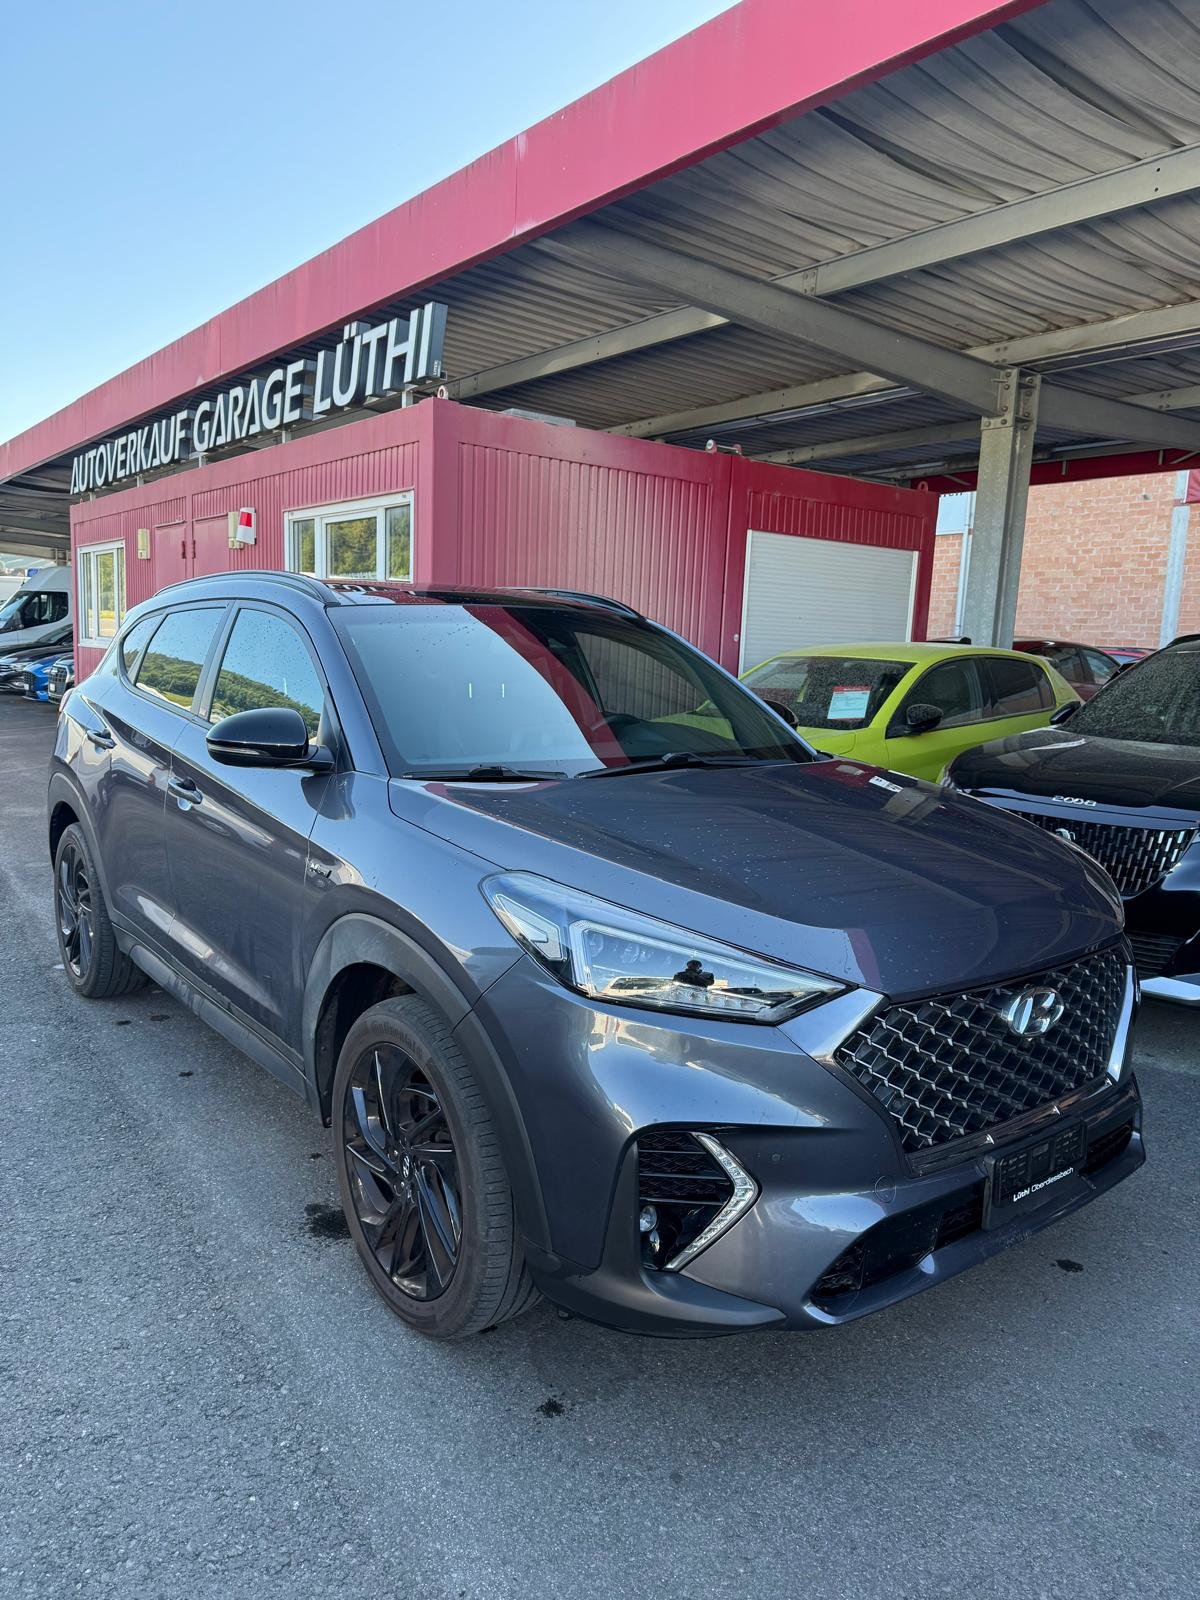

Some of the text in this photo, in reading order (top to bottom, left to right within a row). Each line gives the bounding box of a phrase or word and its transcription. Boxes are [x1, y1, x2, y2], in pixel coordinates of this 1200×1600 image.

[70, 301, 436, 495] AUTOVERKAUF GARAGE LÜTHI
[1051, 795, 1097, 807] 2008
